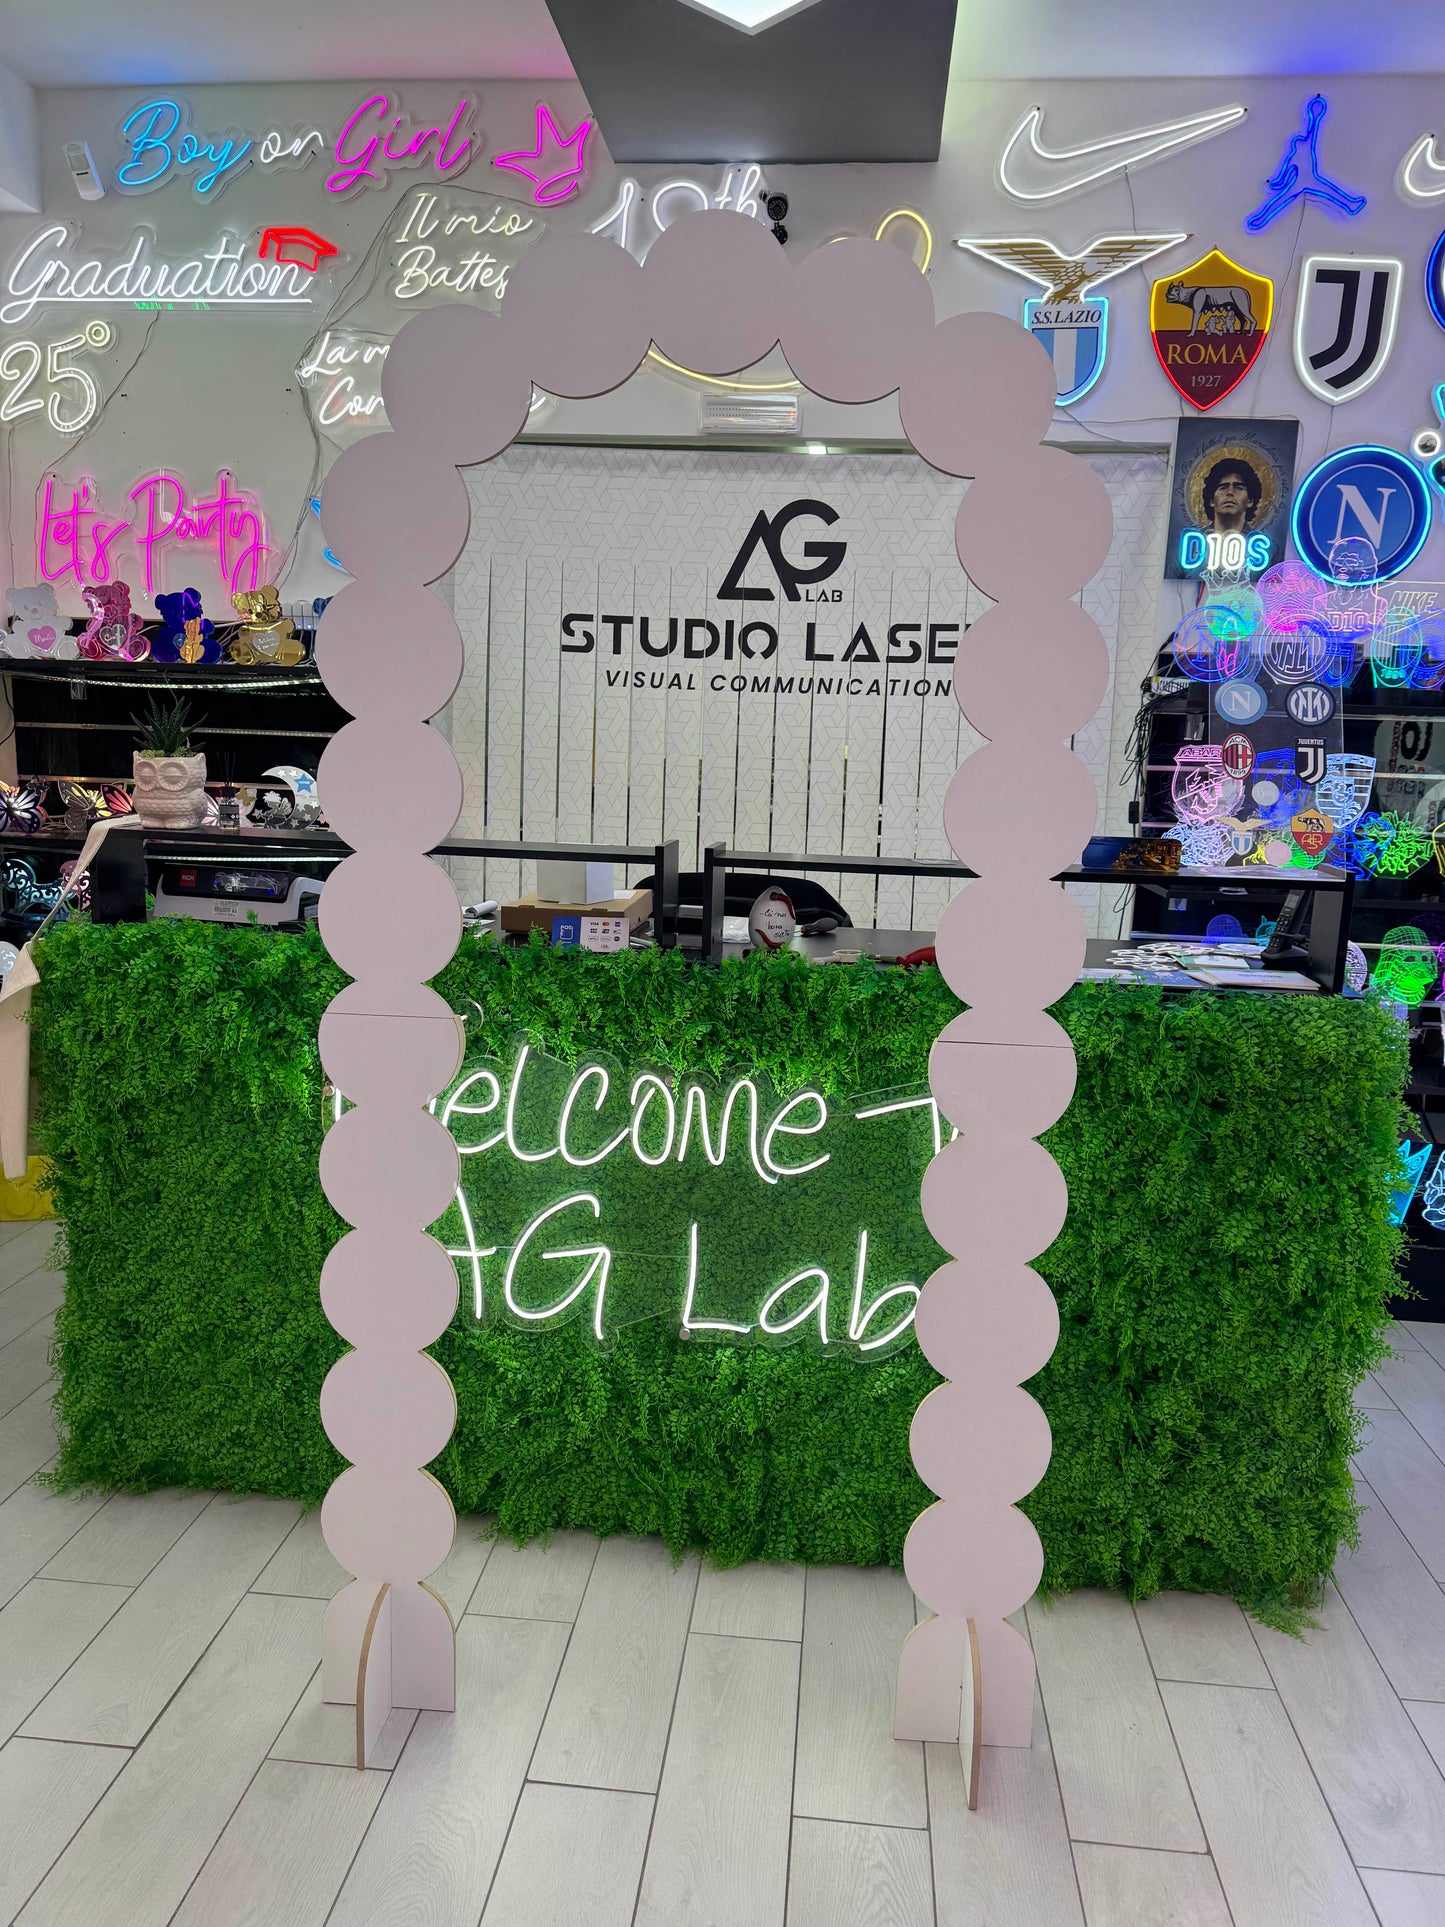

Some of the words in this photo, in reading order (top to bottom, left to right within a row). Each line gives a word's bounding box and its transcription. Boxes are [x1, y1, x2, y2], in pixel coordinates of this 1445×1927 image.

[118, 100, 252, 192] Boy
[327, 96, 473, 192] Girl
[395, 192, 441, 244] Il
[445, 206, 533, 236] mio
[0, 226, 313, 323] Graduation
[302, 331, 358, 377] La
[1166, 343, 1249, 366] ROMA
[1190, 374, 1222, 389] 1927
[40, 480, 131, 586] Let's
[130, 475, 272, 594] Party
[1327, 484, 1397, 550] N
[716, 498, 848, 602] AG
[805, 589, 843, 603] LAB
[561, 612, 779, 661] STUDIO
[804, 621, 972, 664] LASE
[605, 669, 698, 691] VISUAL
[709, 674, 952, 697] COMMUNICATION
[1229, 691, 1252, 713] N
[1297, 738, 1325, 746] JUVENTUS
[1228, 768, 1247, 777] 1899
[334, 1044, 830, 1184] elcome
[682, 1223, 921, 1352] Lab
